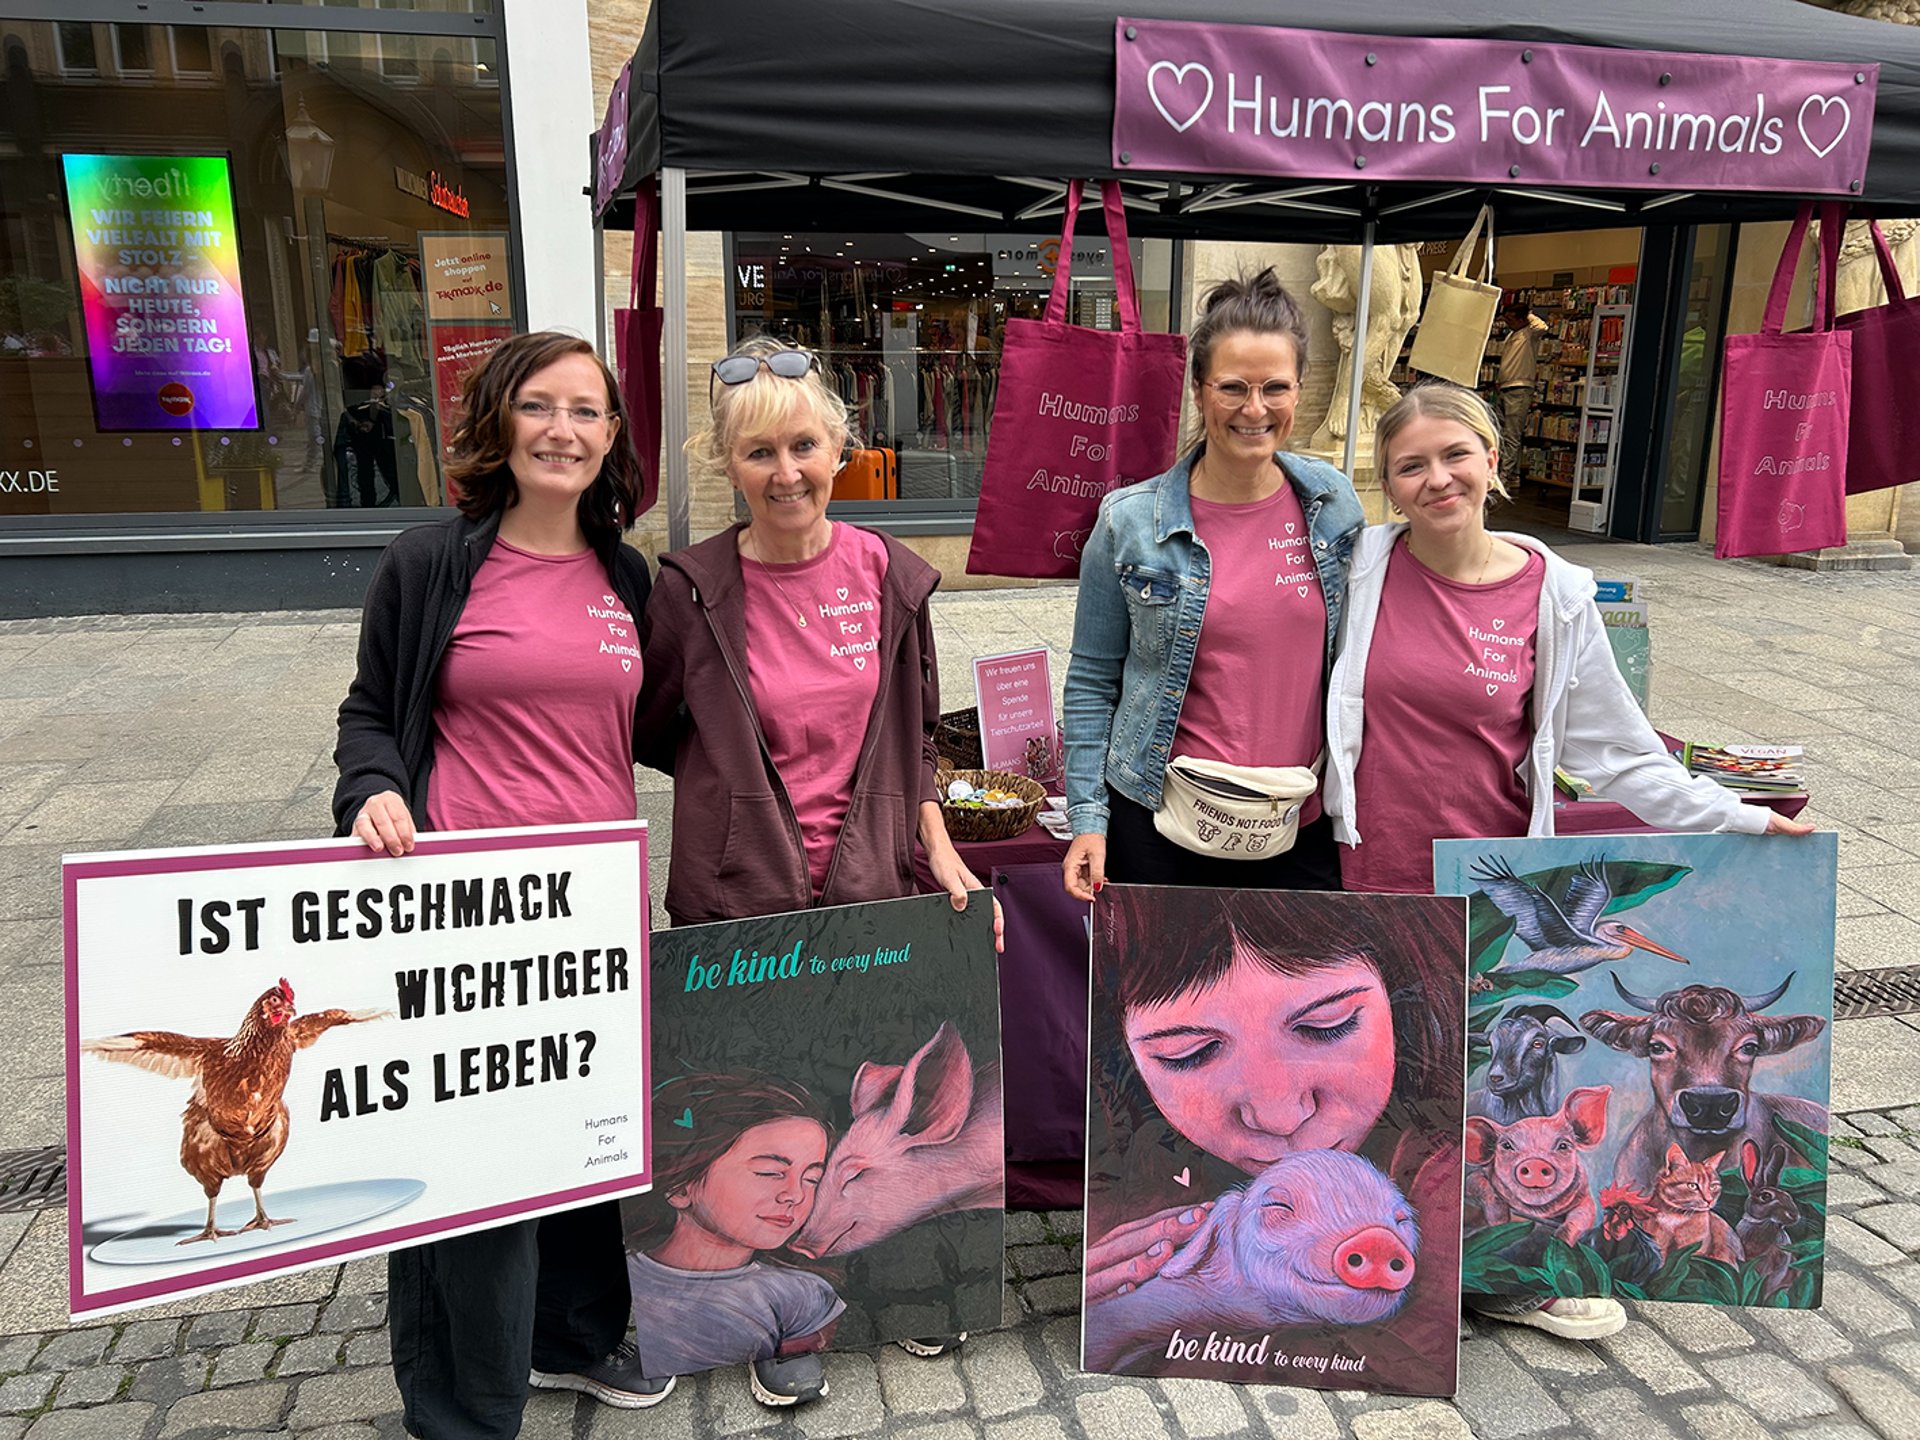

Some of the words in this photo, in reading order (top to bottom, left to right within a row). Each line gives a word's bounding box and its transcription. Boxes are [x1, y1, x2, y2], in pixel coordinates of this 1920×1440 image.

[1227, 72, 1457, 144] Humans
[1478, 85, 1566, 147] For
[1580, 89, 1785, 155] Animals
[90, 208, 135, 226] WIR
[140, 209, 213, 227] FEIERN
[86, 228, 178, 246] VIELFALT
[183, 231, 222, 247] MIT
[119, 250, 183, 265] STOLZ
[434, 256, 460, 268] Jetzt
[461, 252, 492, 264] online
[443, 263, 487, 277] shoppen
[104, 277, 170, 294] NICHT
[175, 279, 221, 295] NUR
[128, 298, 200, 317] HEUTE,
[116, 318, 217, 334] SONDERN
[112, 337, 180, 353] JEDEN
[183, 338, 233, 353] TAG!
[1268, 536, 1310, 550] Human
[1285, 552, 1306, 566] For
[818, 600, 875, 618] Humans
[607, 623, 628, 638] For
[839, 621, 863, 635] For
[1468, 626, 1525, 647] Humans
[1483, 647, 1506, 662] For
[984, 667, 998, 677] Wir
[999, 664, 1022, 675] freuen
[1022, 661, 1036, 671] uns
[1463, 662, 1518, 683] Animals
[1013, 678, 1029, 688] eine
[1001, 694, 1029, 706] Spende
[1009, 708, 1033, 720] unsere
[990, 719, 1044, 737] Tierschutzarbeit
[1740, 747, 1787, 755] VEGAN
[991, 757, 1022, 770] HUMANS
[1192, 798, 1236, 827] FRIENDS
[1235, 818, 1257, 830] NOT
[178, 897, 266, 956] IST
[291, 871, 573, 944] GESCHMACK
[684, 954, 724, 993] be
[727, 940, 804, 987] kind
[809, 955, 826, 975] to
[831, 952, 871, 974] every
[873, 942, 912, 967] kind
[394, 947, 629, 1021] WICHTIGER
[319, 1058, 410, 1123] ALS
[432, 1030, 597, 1104] LEBEN?
[584, 1114, 629, 1130] Humans
[598, 1134, 617, 1146] For
[584, 1149, 629, 1169] Animals
[1164, 1328, 1201, 1361] be
[1201, 1330, 1271, 1366] kind
[1274, 1350, 1289, 1367] to
[1291, 1355, 1329, 1375] every
[1330, 1353, 1367, 1373] kind
